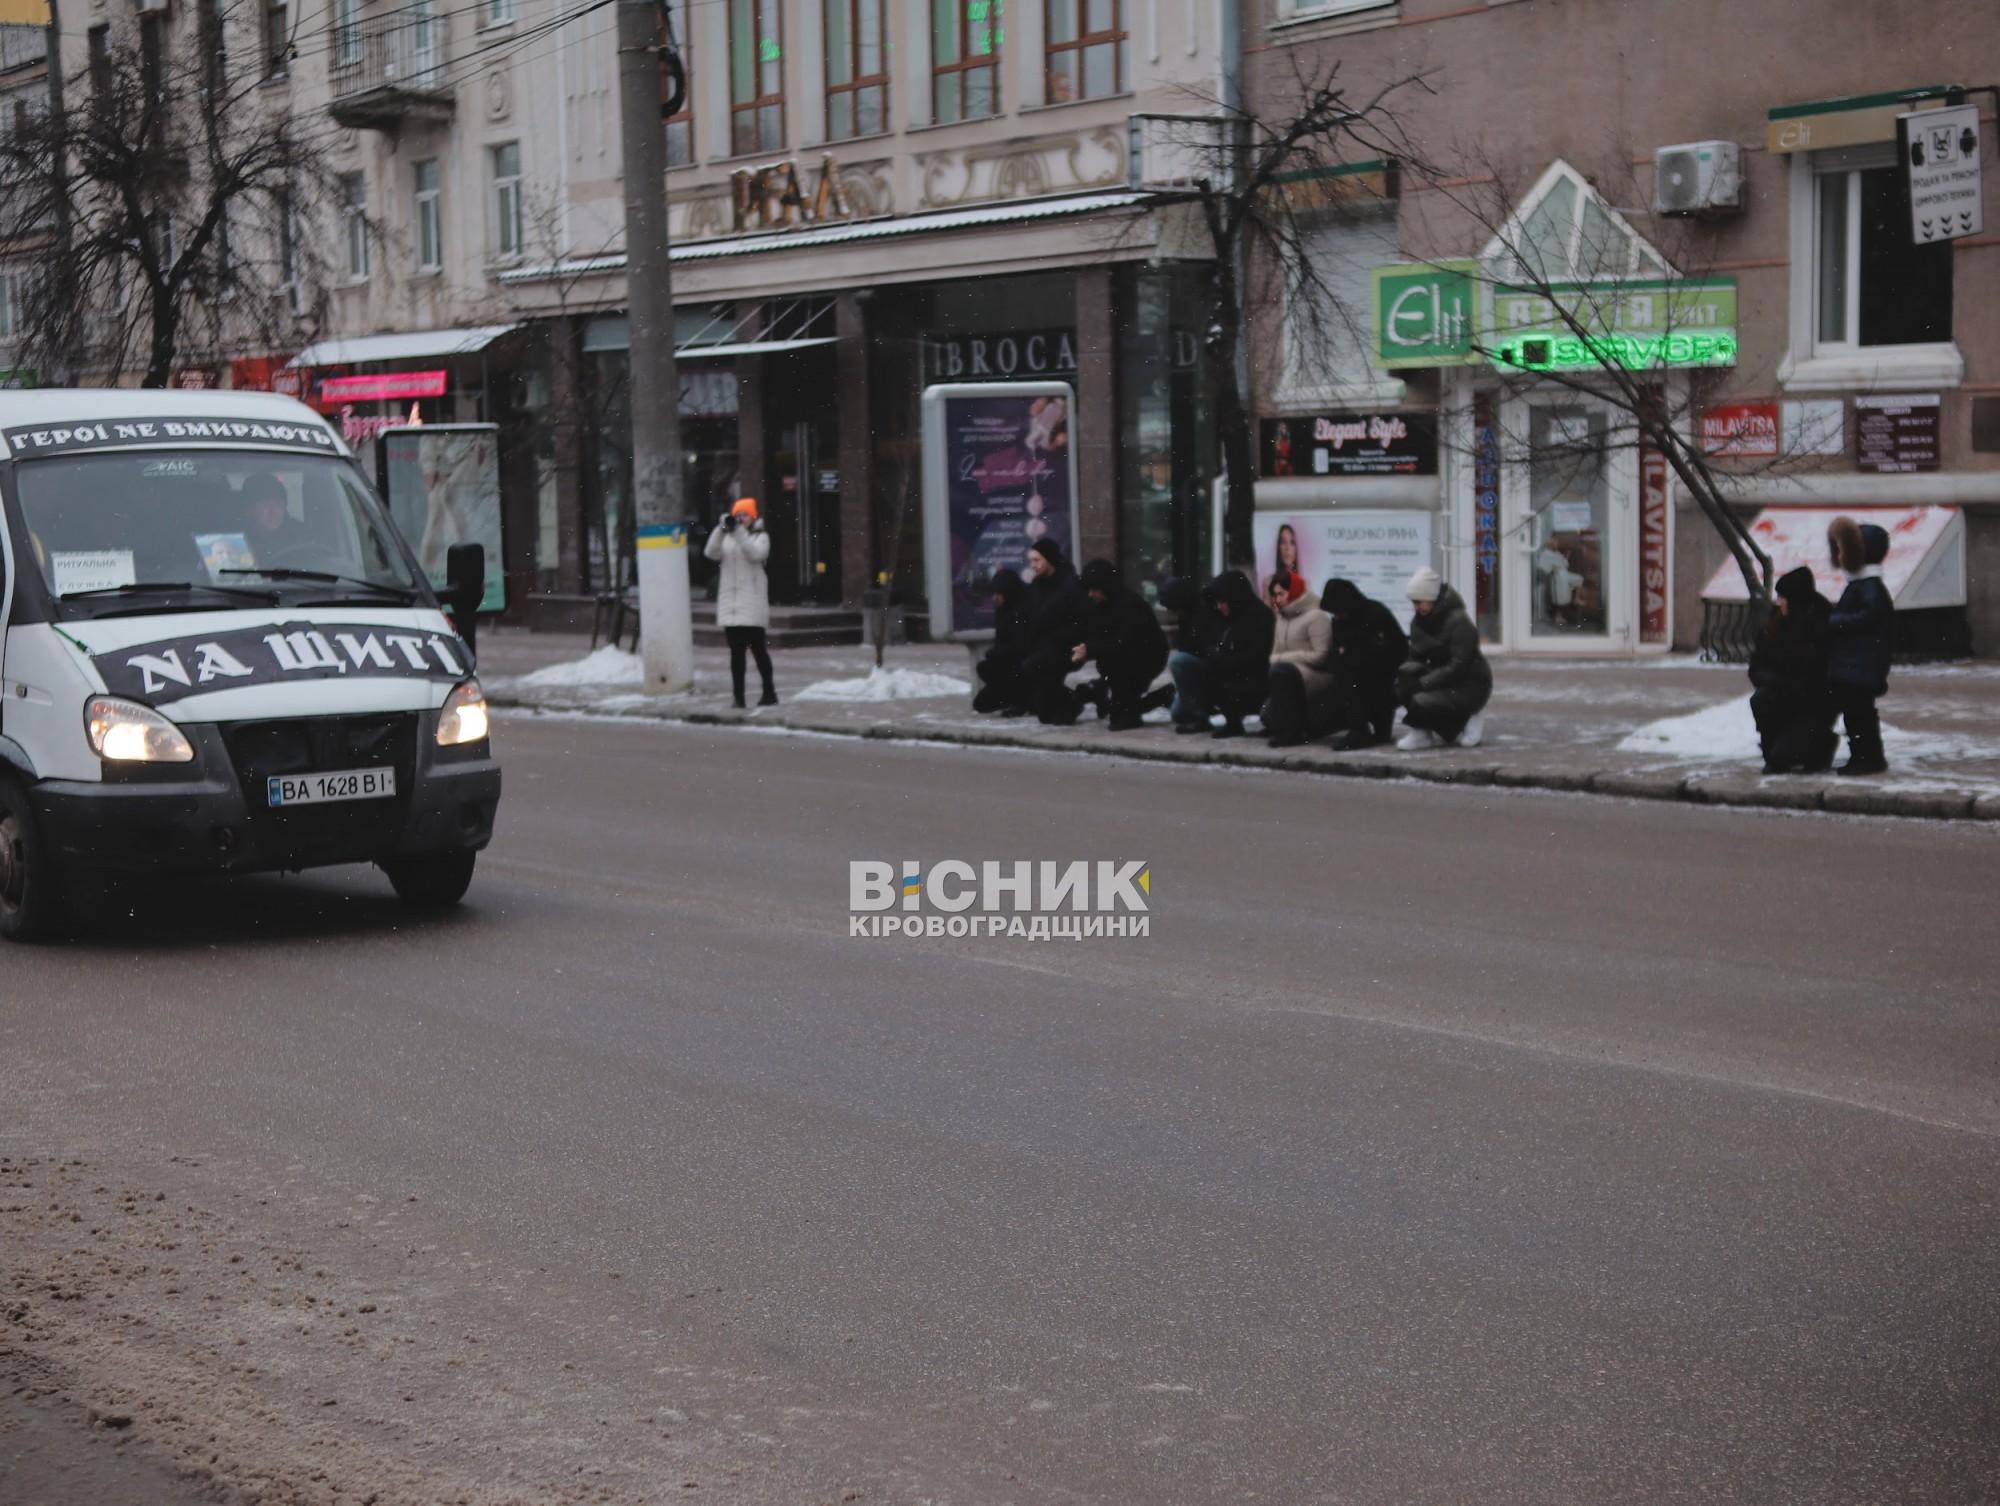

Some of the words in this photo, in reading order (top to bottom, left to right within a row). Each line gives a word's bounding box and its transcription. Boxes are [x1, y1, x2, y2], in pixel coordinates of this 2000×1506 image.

[1387, 282, 1469, 347] Elit
[163, 420, 332, 446] ВМИРАЮТЬ
[1313, 417, 1367, 450] Elegant
[1369, 416, 1407, 449] Style
[1703, 415, 1777, 436] MILAVITSA
[56, 558, 117, 568] РИТУАЛЬНА
[262, 630, 465, 676] ЩИТІ
[282, 780, 310, 800] BA
[317, 775, 358, 798] 1628
